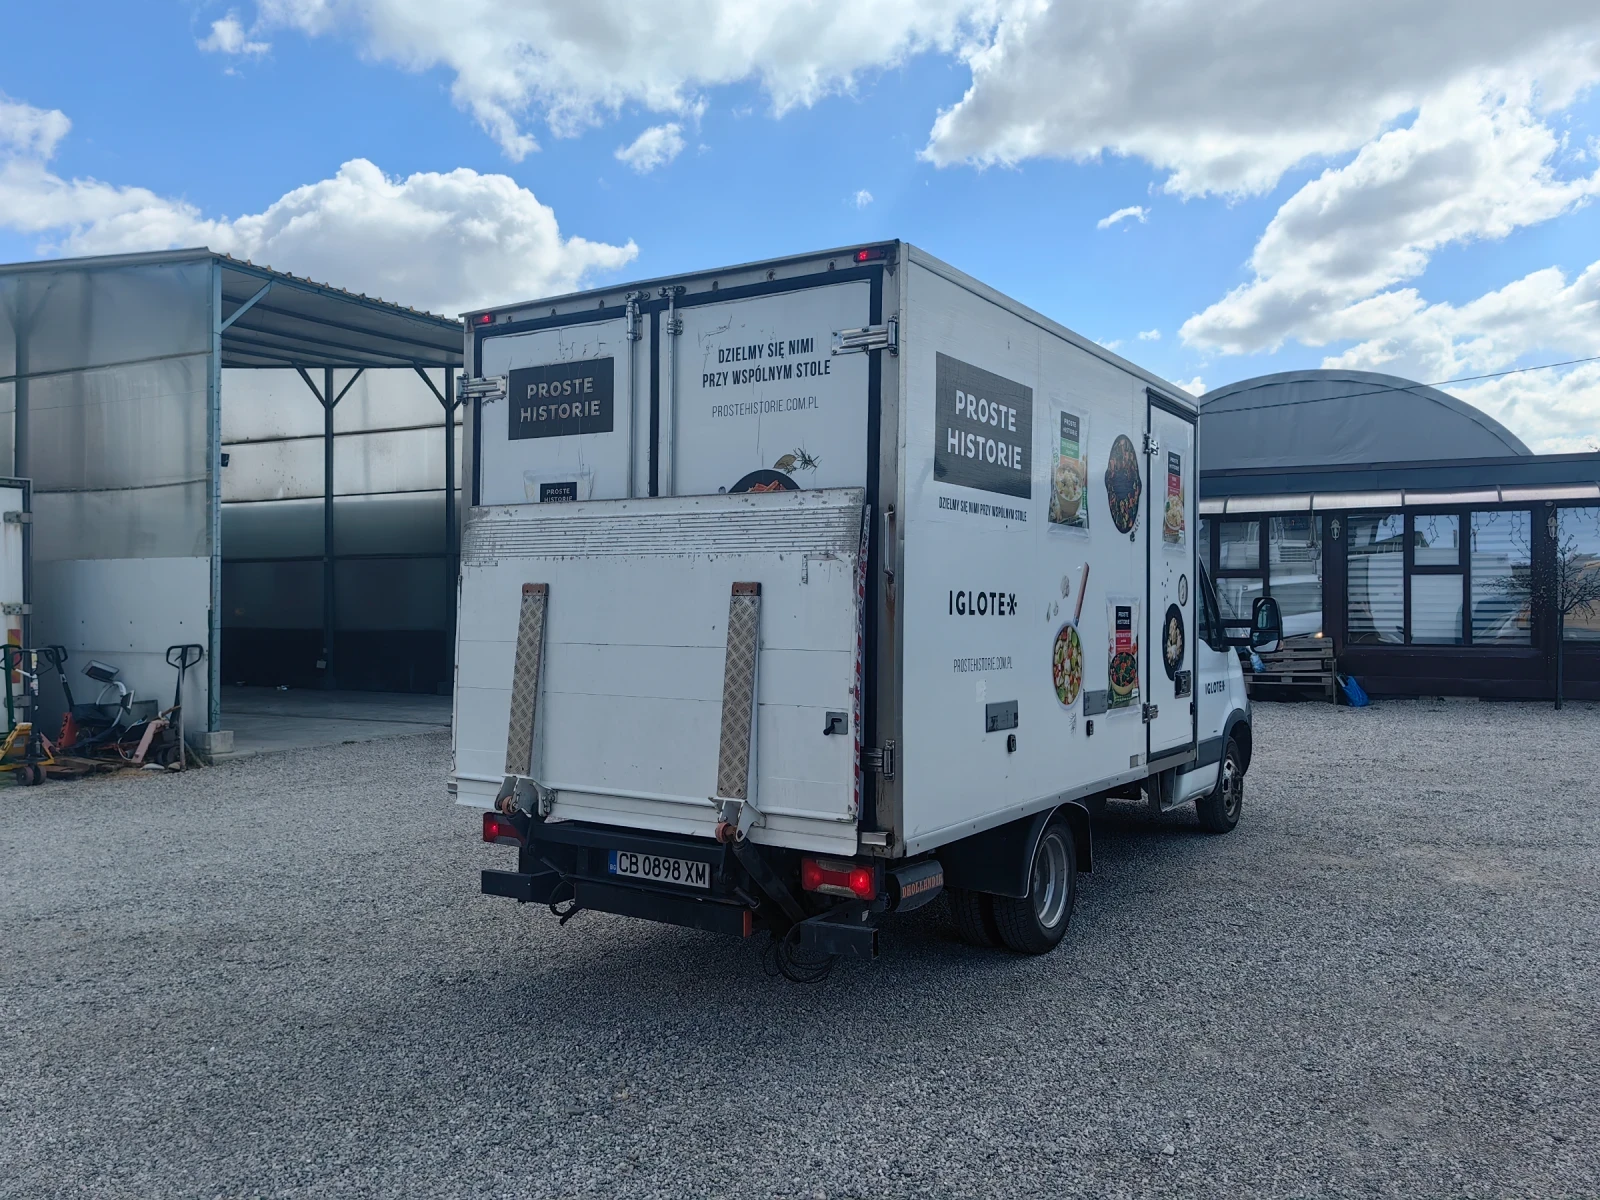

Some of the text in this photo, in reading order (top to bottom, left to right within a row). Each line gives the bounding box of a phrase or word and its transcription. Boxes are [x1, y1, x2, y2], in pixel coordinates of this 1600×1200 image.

[718, 337, 814, 363] DZIELMY SIĘ NIMI
[702, 359, 831, 388] PRZY WSPÓLNYM STOLE
[527, 377, 594, 399] PROSTE
[520, 400, 601, 423] HISTORIE
[711, 396, 819, 418] PROSTEHISTORIE.COM.PL
[955, 389, 1017, 432] PROSTE
[947, 427, 1022, 470] HISTORIE
[546, 487, 571, 495] PROSTE
[939, 497, 1027, 522] DZIELMY SIĘ NIMI PRZY WSPÓLNYM STOLE
[949, 590, 1018, 616] IGLOTEX
[953, 655, 1013, 673] PROSTEHISTORIE.COM.PL
[618, 852, 707, 885] CB 0898 XM
